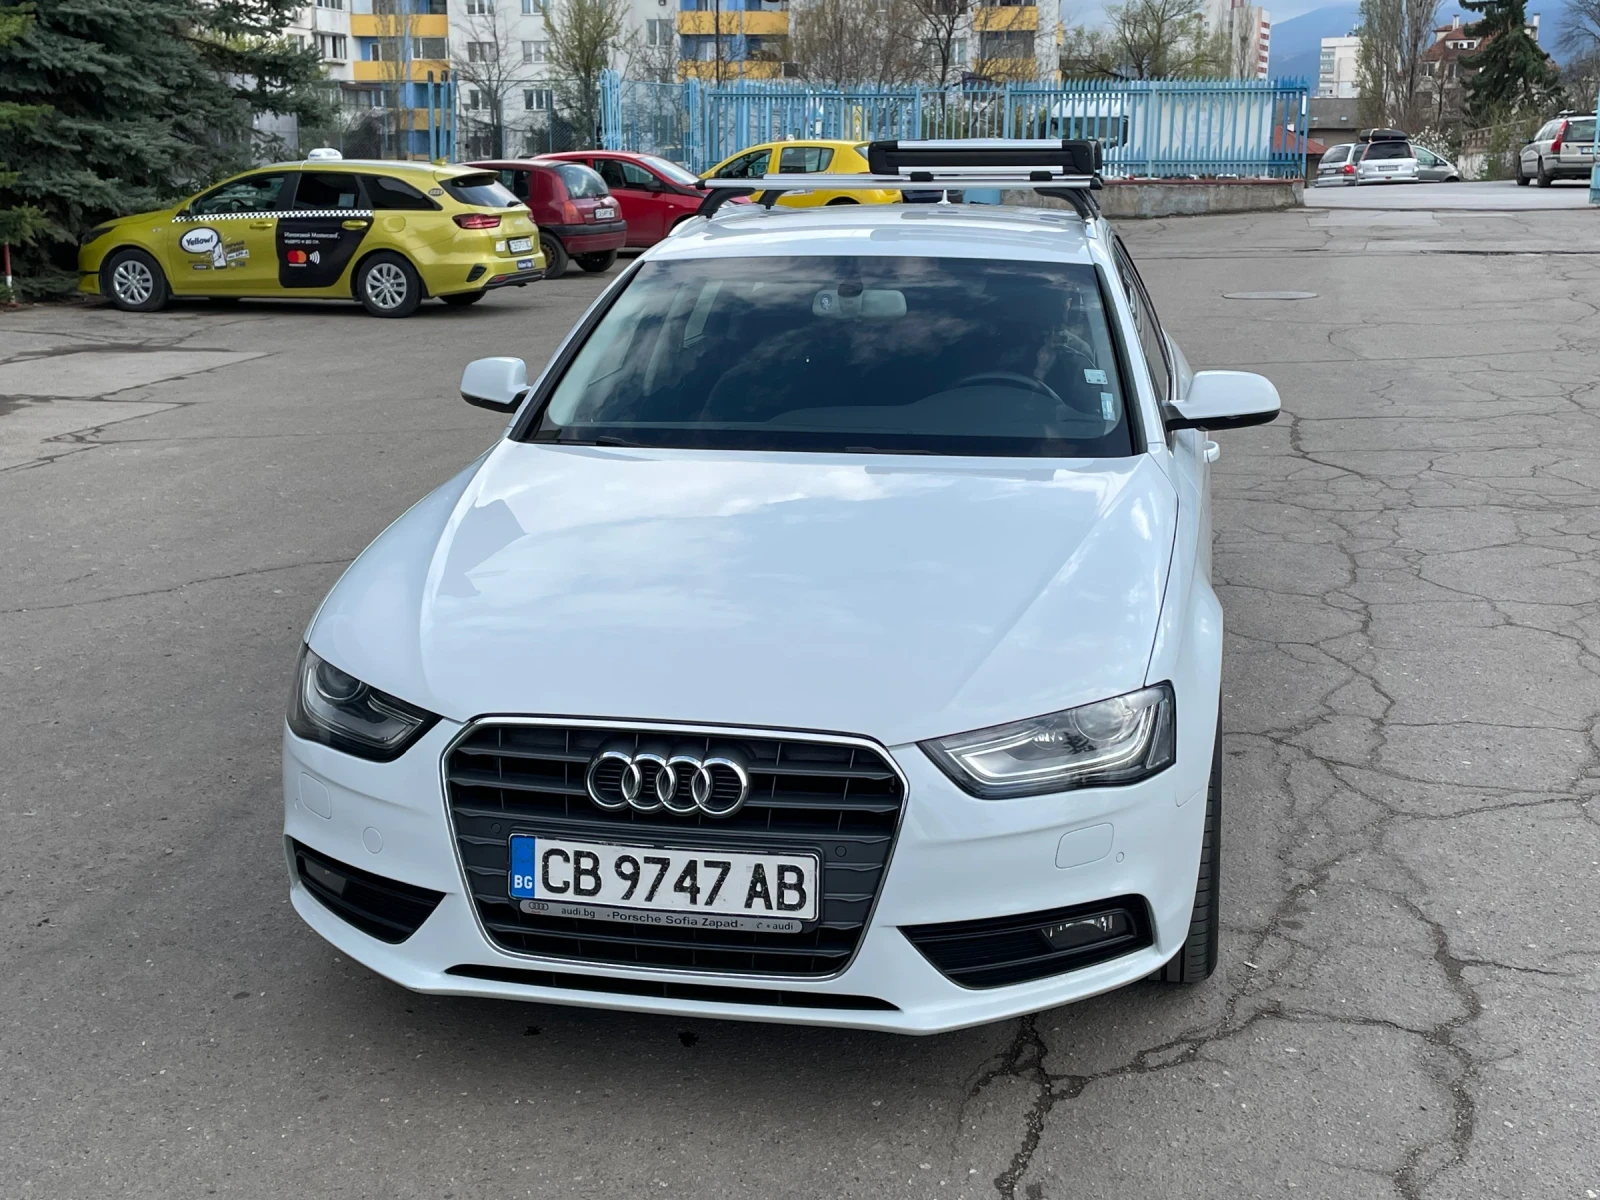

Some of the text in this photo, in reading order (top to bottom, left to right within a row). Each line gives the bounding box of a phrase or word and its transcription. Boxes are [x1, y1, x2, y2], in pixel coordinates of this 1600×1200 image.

[186, 234, 214, 247] Yellow!
[513, 874, 533, 890] BG
[541, 848, 808, 912] CB 9747 AB
[561, 906, 596, 919] audi.bg
[611, 911, 738, 930] Porsche Sofia Zapad
[772, 921, 794, 931] audi
